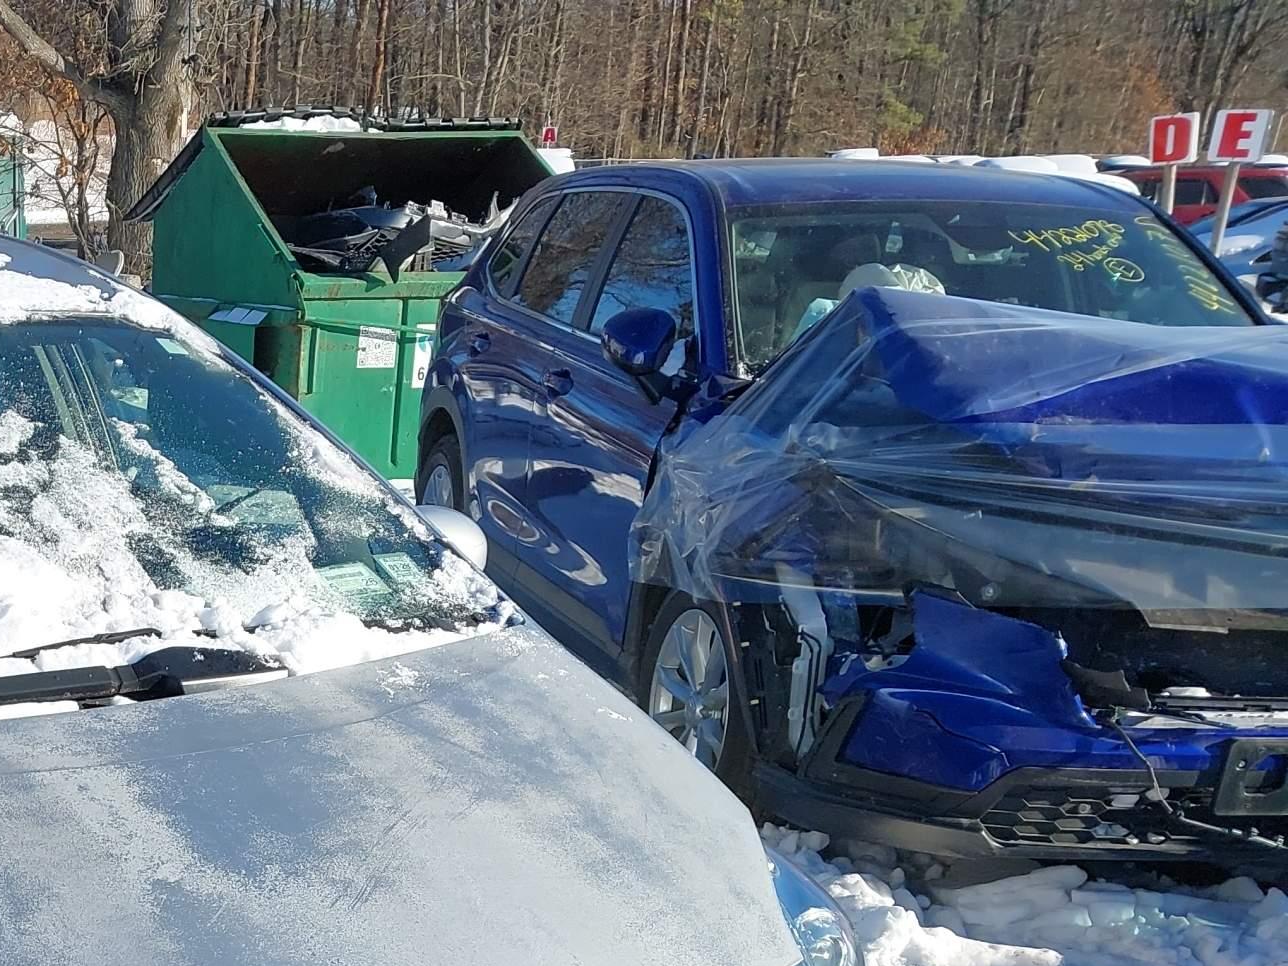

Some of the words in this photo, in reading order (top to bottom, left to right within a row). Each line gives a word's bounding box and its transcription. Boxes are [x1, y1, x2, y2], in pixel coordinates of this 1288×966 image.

[543, 127, 556, 142] A
[1153, 117, 1192, 162] D
[1216, 112, 1258, 158] E
